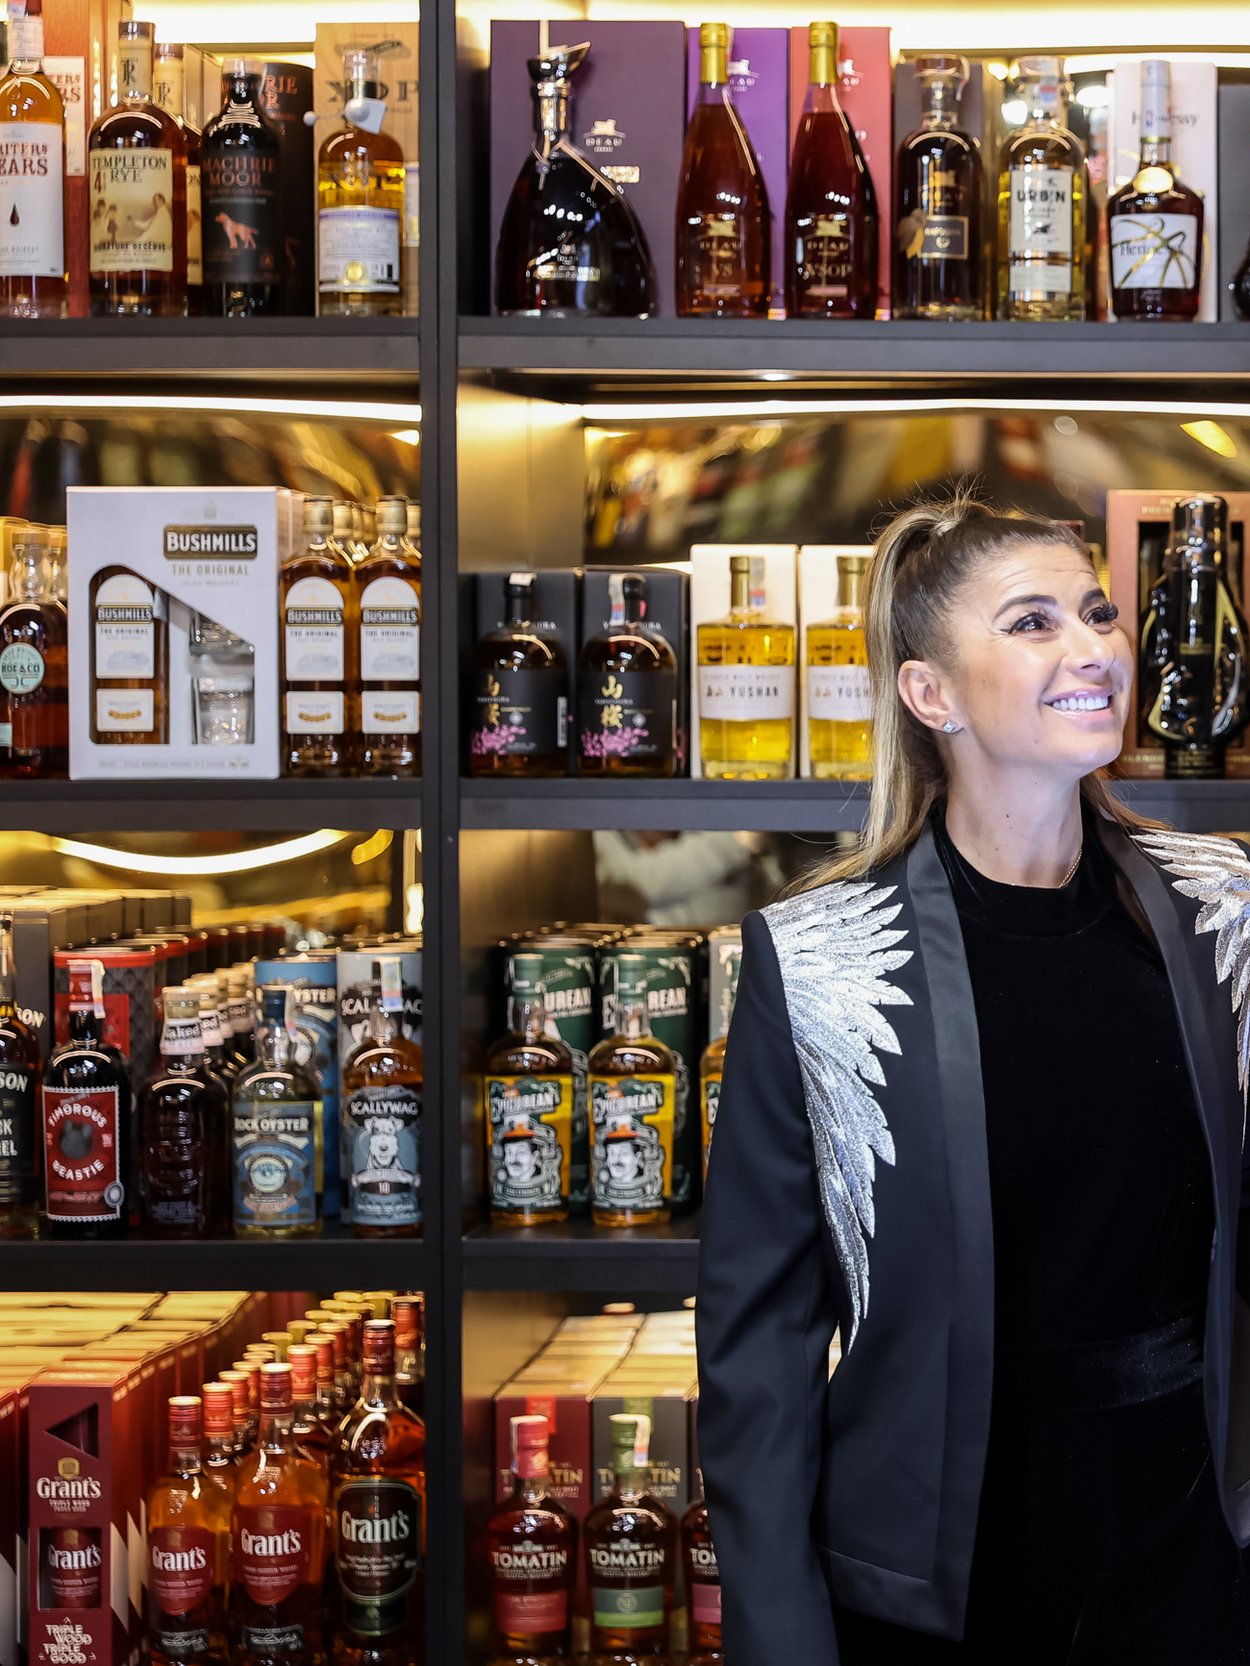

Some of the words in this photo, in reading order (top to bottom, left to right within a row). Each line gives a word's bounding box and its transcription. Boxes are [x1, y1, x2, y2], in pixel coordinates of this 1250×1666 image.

[92, 154, 168, 171] TEMPLETON
[110, 170, 143, 184] RYE
[166, 531, 257, 553] BUSHMILLS
[172, 564, 191, 577] THE
[196, 564, 249, 577] ORIGINAL
[97, 607, 153, 622] BUSHMILLS
[287, 610, 342, 624] BUSHMILLS
[362, 610, 418, 624] BUSHMILLS
[48, 1103, 107, 1128] TIMOROUS
[350, 1100, 419, 1116] SCALLYWAG
[261, 1117, 310, 1131] OYSTER
[52, 1159, 105, 1181] BEASTIE
[36, 1477, 102, 1498] Grant's
[342, 1509, 410, 1543] Grant's
[241, 1528, 301, 1556] Grant's
[152, 1545, 206, 1571] Grant's
[491, 1551, 567, 1569] TOMATIN
[589, 1549, 665, 1567] TOMATIN
[45, 1624, 83, 1637] TRIPLE
[54, 1634, 93, 1645] WOOD
[43, 1643, 81, 1655] TRIPLE
